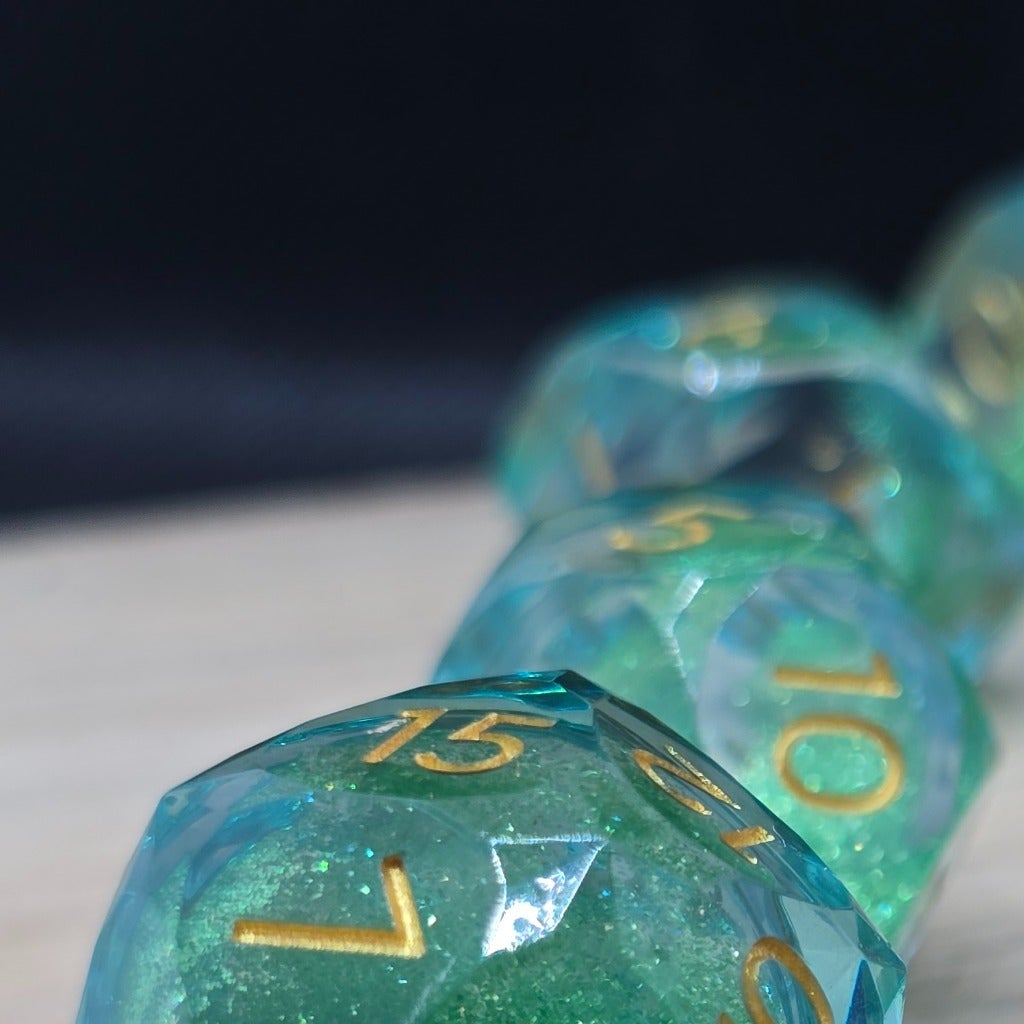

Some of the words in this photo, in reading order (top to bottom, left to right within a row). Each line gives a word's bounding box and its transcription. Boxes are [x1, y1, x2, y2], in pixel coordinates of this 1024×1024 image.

[363, 707, 556, 774] 15
[774, 652, 906, 814] 10
[231, 854, 427, 959] 7
